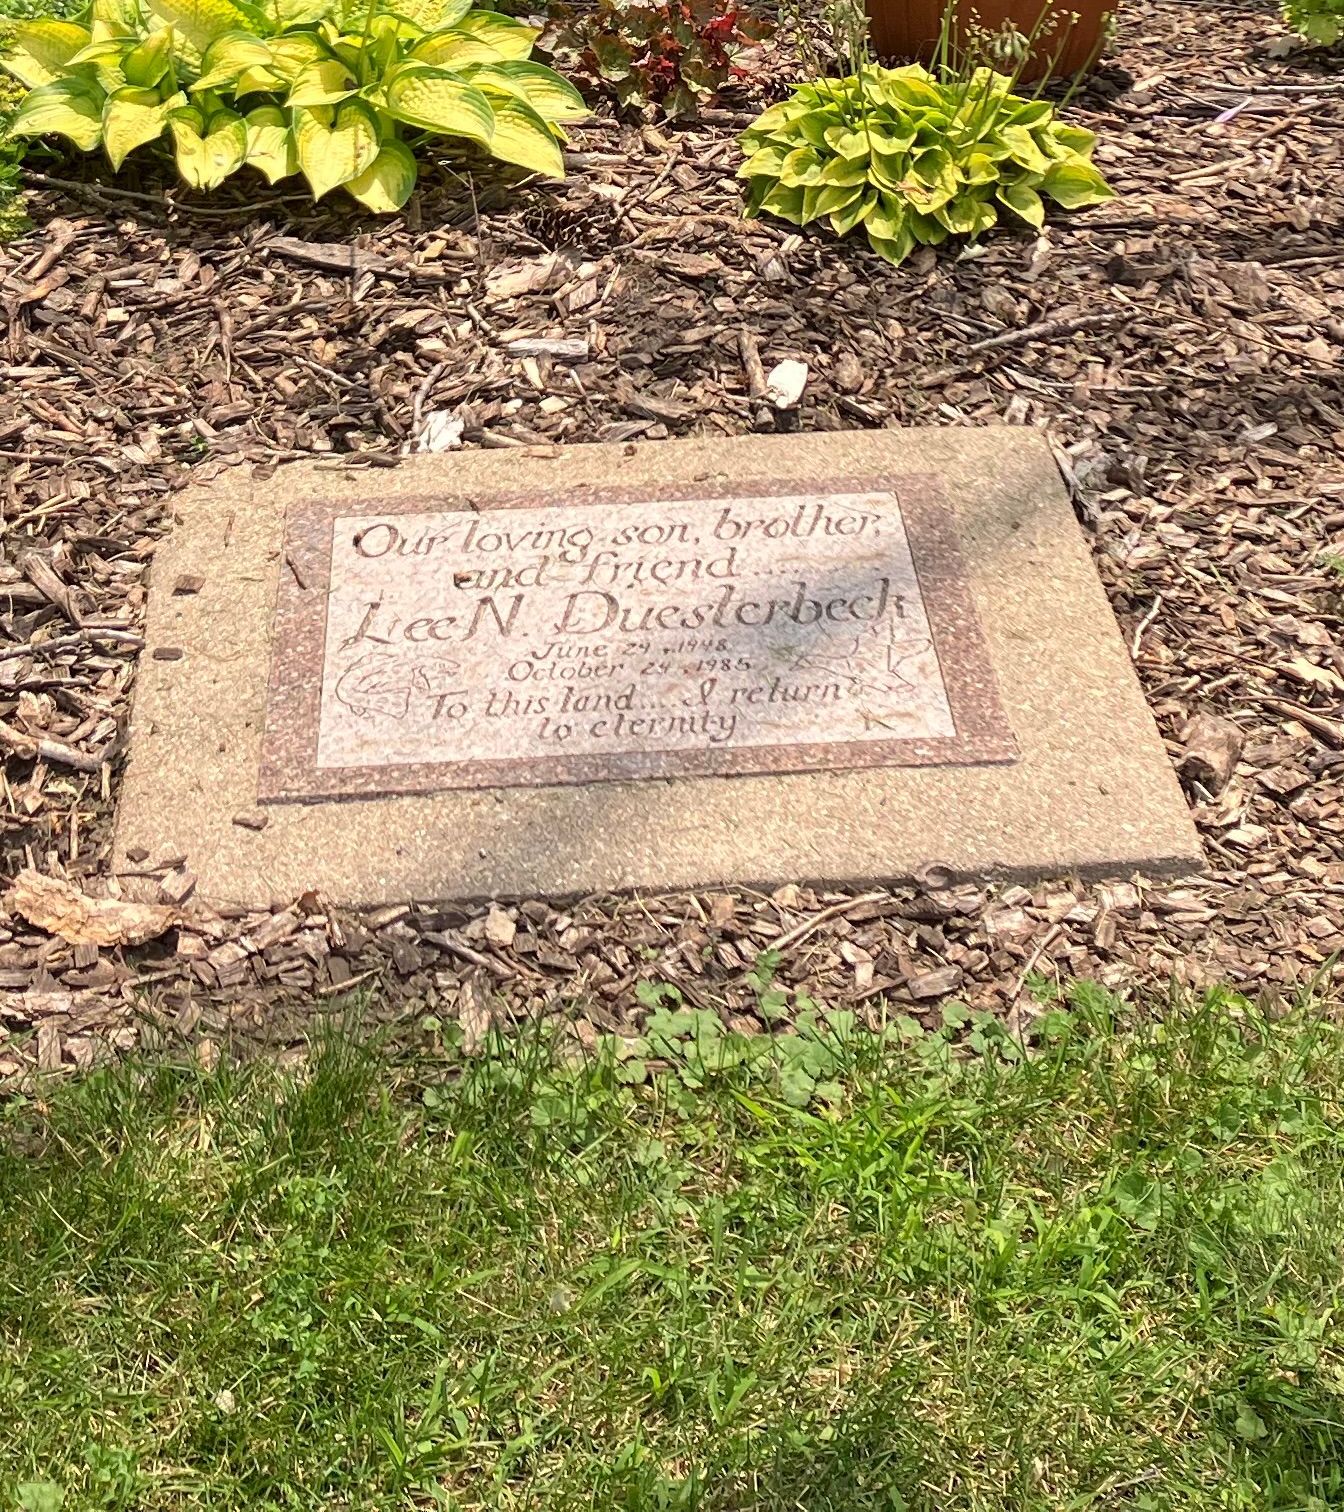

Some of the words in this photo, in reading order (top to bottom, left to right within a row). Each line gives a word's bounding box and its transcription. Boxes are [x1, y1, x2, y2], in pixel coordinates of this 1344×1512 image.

[353, 523, 449, 557] Our
[461, 520, 594, 563] loving
[455, 555, 550, 588] and
[343, 601, 456, 646] Lee
[554, 577, 906, 635] Duesterbeck
[531, 642, 608, 660] June
[508, 660, 624, 681] October
[426, 690, 468, 720] To
[486, 690, 550, 717] this
[731, 677, 841, 704] return
[538, 717, 572, 740] to
[590, 711, 736, 742] eternity
